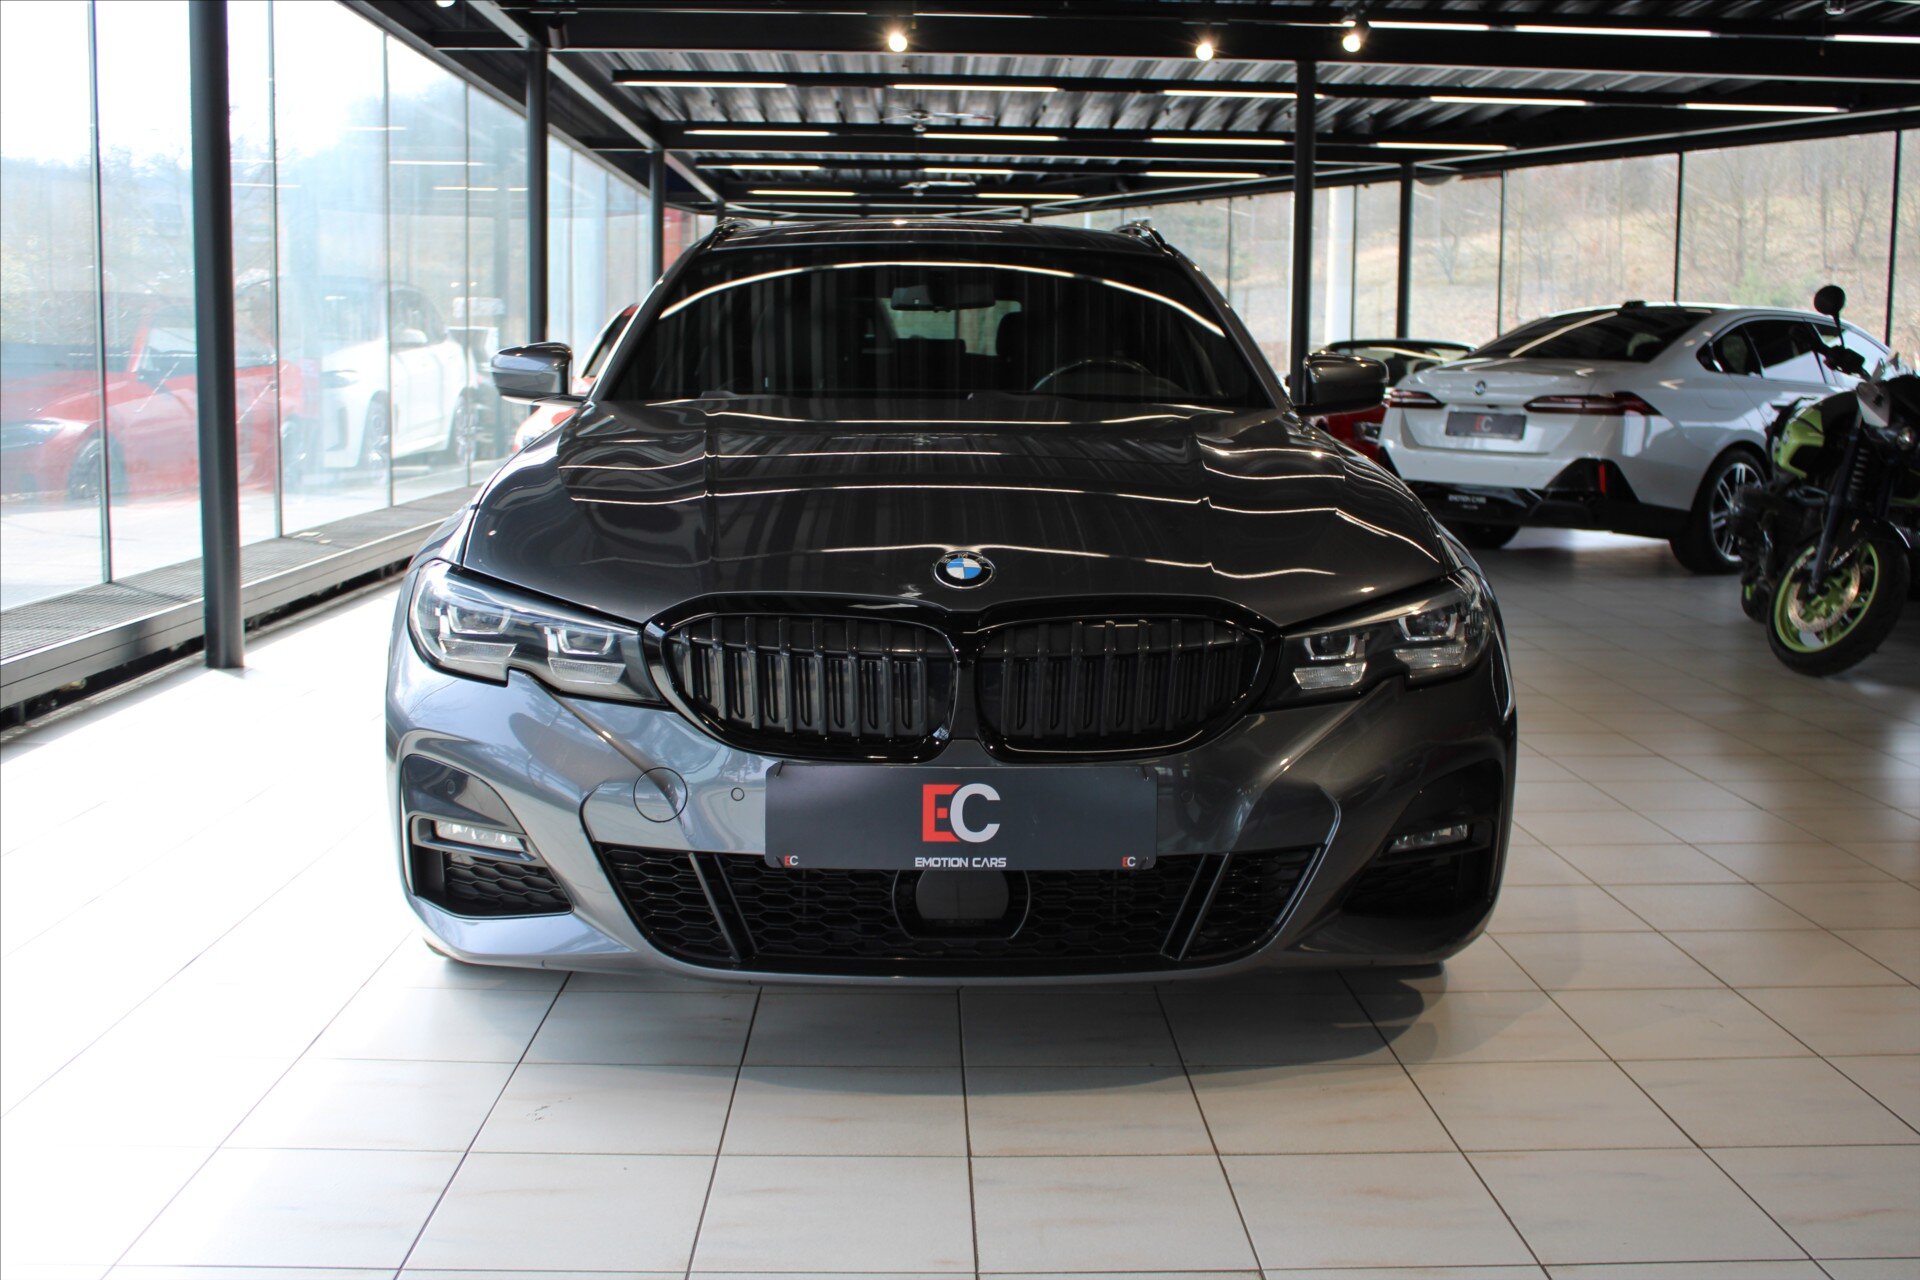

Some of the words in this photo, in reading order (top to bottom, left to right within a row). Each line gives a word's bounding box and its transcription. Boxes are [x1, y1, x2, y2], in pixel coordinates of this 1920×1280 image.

[922, 783, 1001, 843] EC
[784, 855, 799, 867] EC
[915, 857, 968, 868] EMOTION
[972, 857, 1007, 868] CARS
